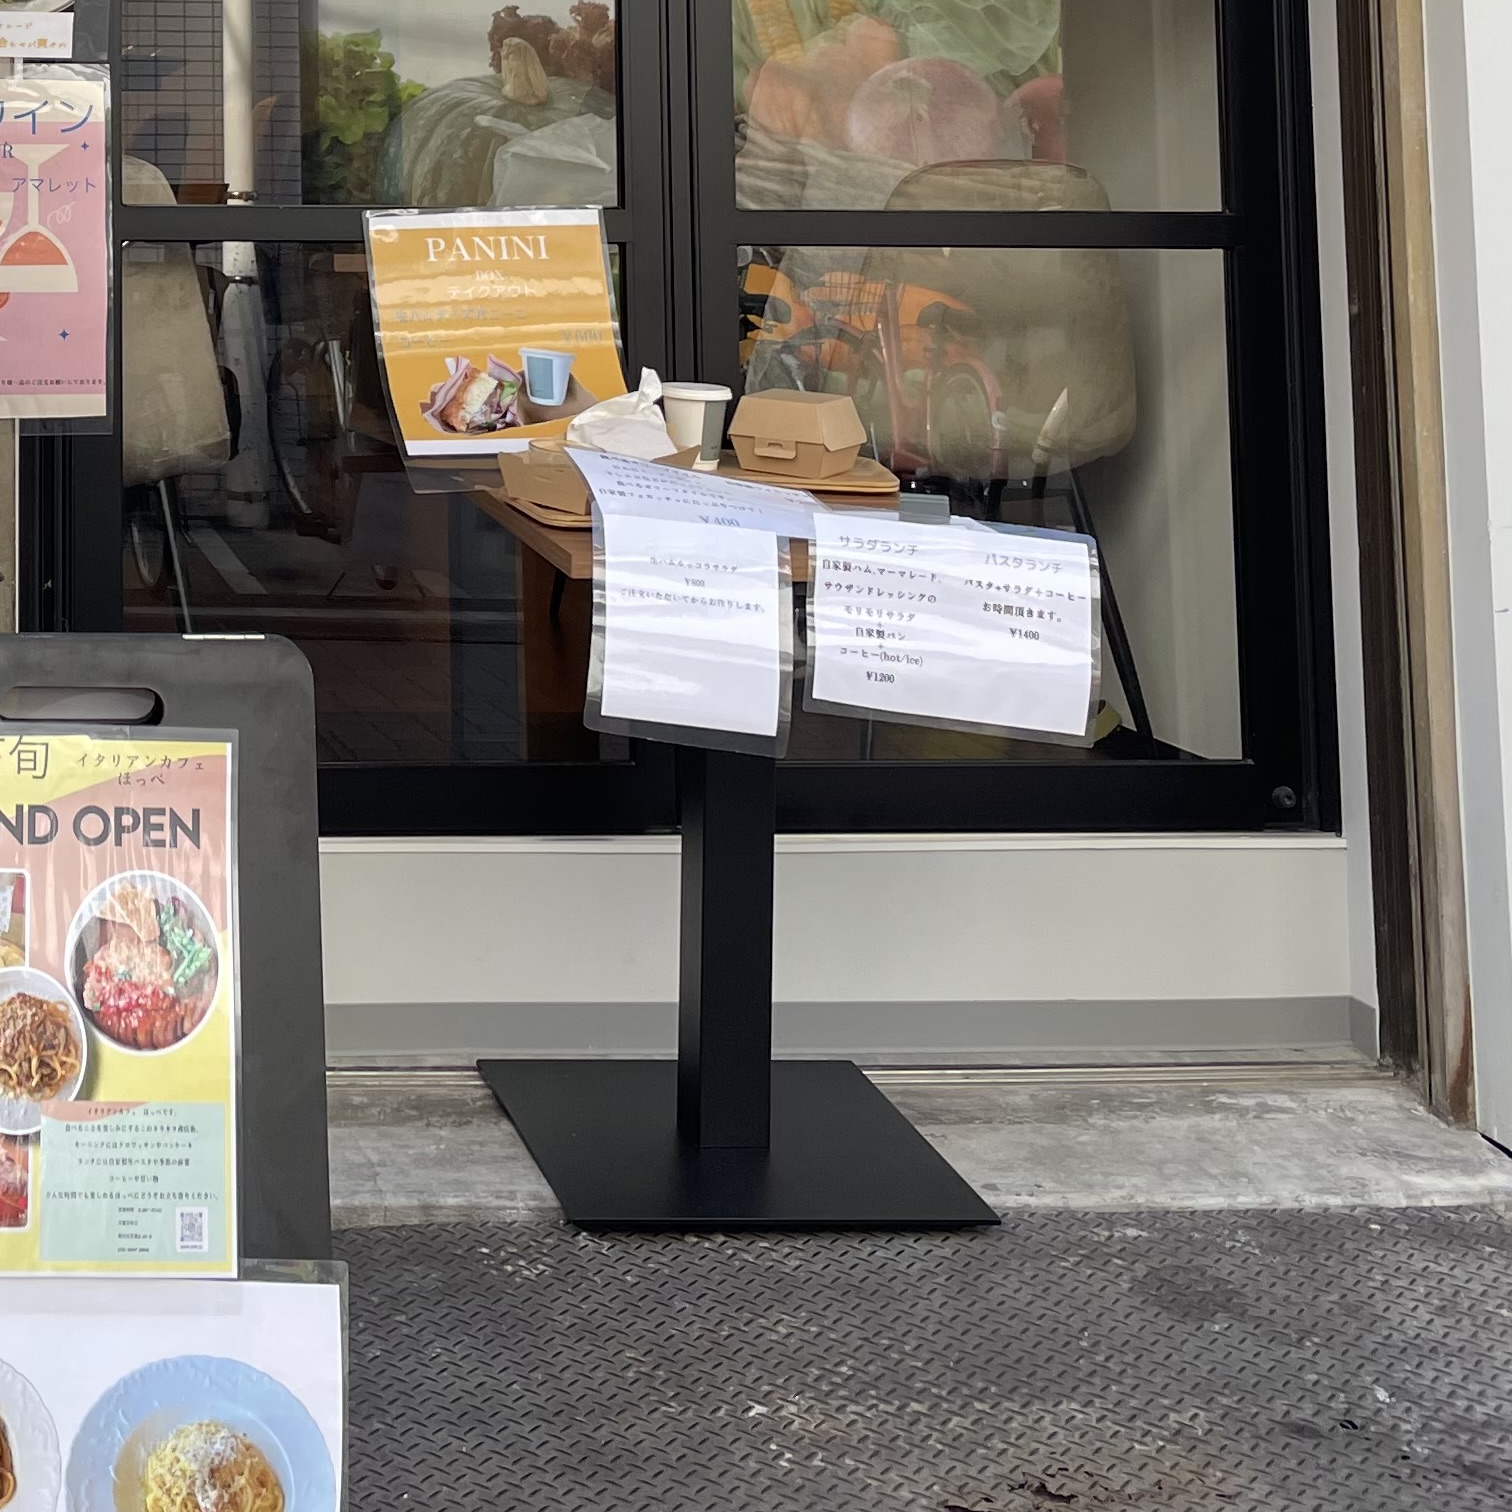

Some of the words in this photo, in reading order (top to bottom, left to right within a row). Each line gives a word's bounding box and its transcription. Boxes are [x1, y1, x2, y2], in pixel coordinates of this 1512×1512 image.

[11, 176, 97, 194] アマレット
[424, 235, 551, 263] PANINI
[837, 534, 920, 556] サラダランチ
[984, 552, 1064, 574] パスタランチ
[76, 753, 205, 772] イタリアンカフェ
[117, 771, 166, 787] ほっぺ
[71, 805, 202, 849] OPEN
